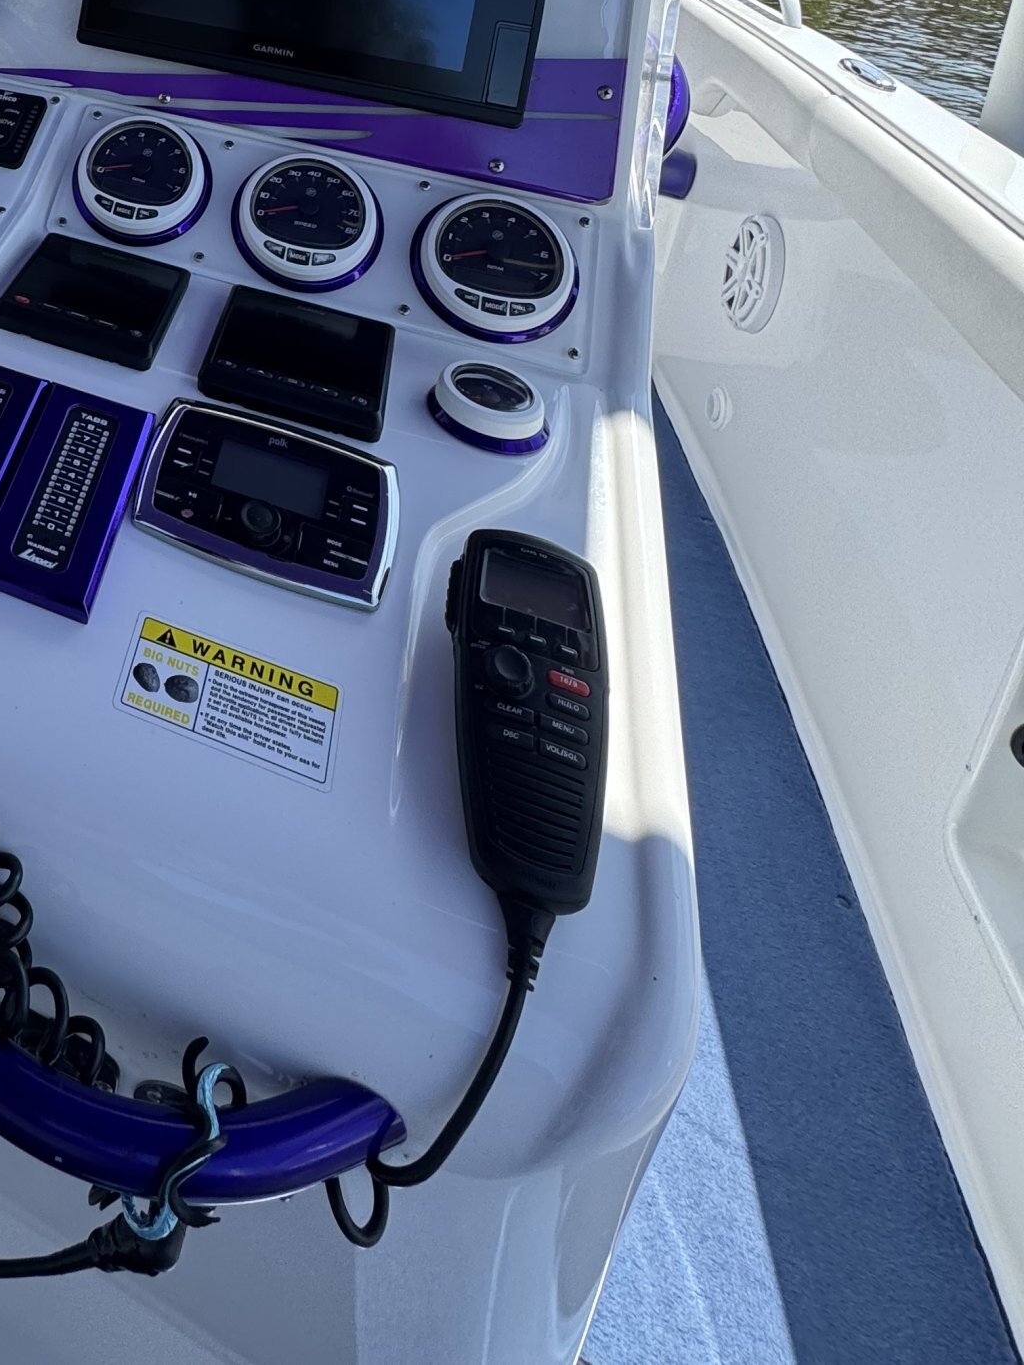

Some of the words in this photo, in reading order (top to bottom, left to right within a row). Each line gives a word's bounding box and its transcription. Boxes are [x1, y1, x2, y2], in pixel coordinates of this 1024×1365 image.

[253, 43, 294, 58] GARMIN
[269, 176, 282, 184] 20
[260, 191, 270, 199] 10
[348, 209, 360, 217] 70
[81, 412, 108, 426] TABS
[268, 436, 289, 449] polk
[27, 540, 59, 556] WARNING
[326, 538, 342, 548] MODE
[323, 558, 339, 569] MENU
[143, 647, 164, 662] BIG
[167, 656, 199, 676] NUTS
[192, 639, 314, 698] WARNING
[215, 670, 247, 687] SERIOUS
[248, 683, 275, 698] INJURY
[276, 695, 289, 704] can
[127, 691, 190, 724] REQUIRED
[497, 702, 523, 715] CLEAR
[558, 698, 580, 712] HI/LO
[503, 729, 519, 739] DSC
[552, 720, 575, 734] MENU
[546, 743, 578, 762] VOL/SQL
